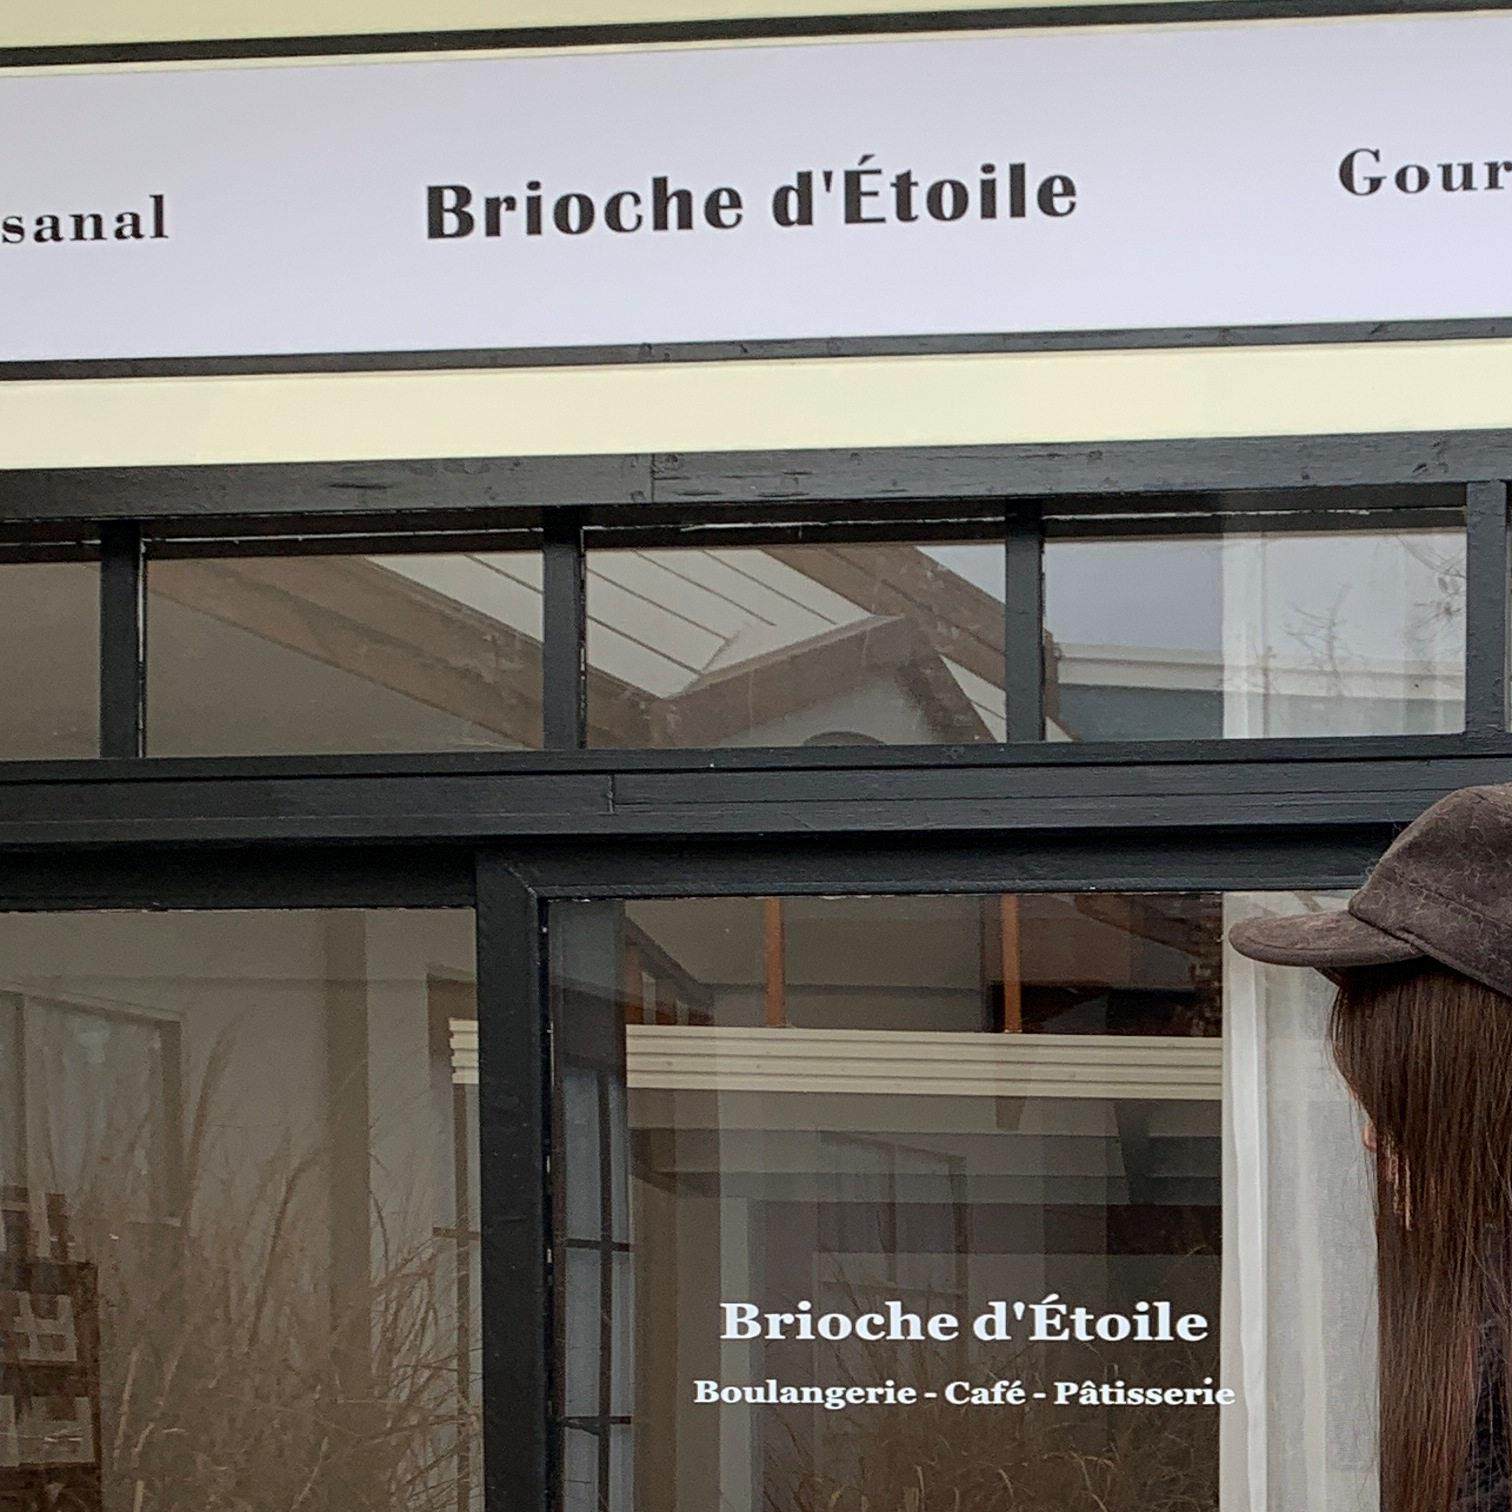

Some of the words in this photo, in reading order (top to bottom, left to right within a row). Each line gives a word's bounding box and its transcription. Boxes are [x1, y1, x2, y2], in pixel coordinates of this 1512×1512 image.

[2, 194, 169, 244] sanal
[427, 175, 743, 240] Brioche
[772, 154, 1078, 228] d'Étoile
[719, 1300, 959, 1341] Brioche
[972, 1293, 1209, 1342] d'Étoile
[693, 1379, 917, 1410] Boulangerie
[944, 1380, 1026, 1405] Café
[1053, 1376, 1236, 1406] Pâtisserie
